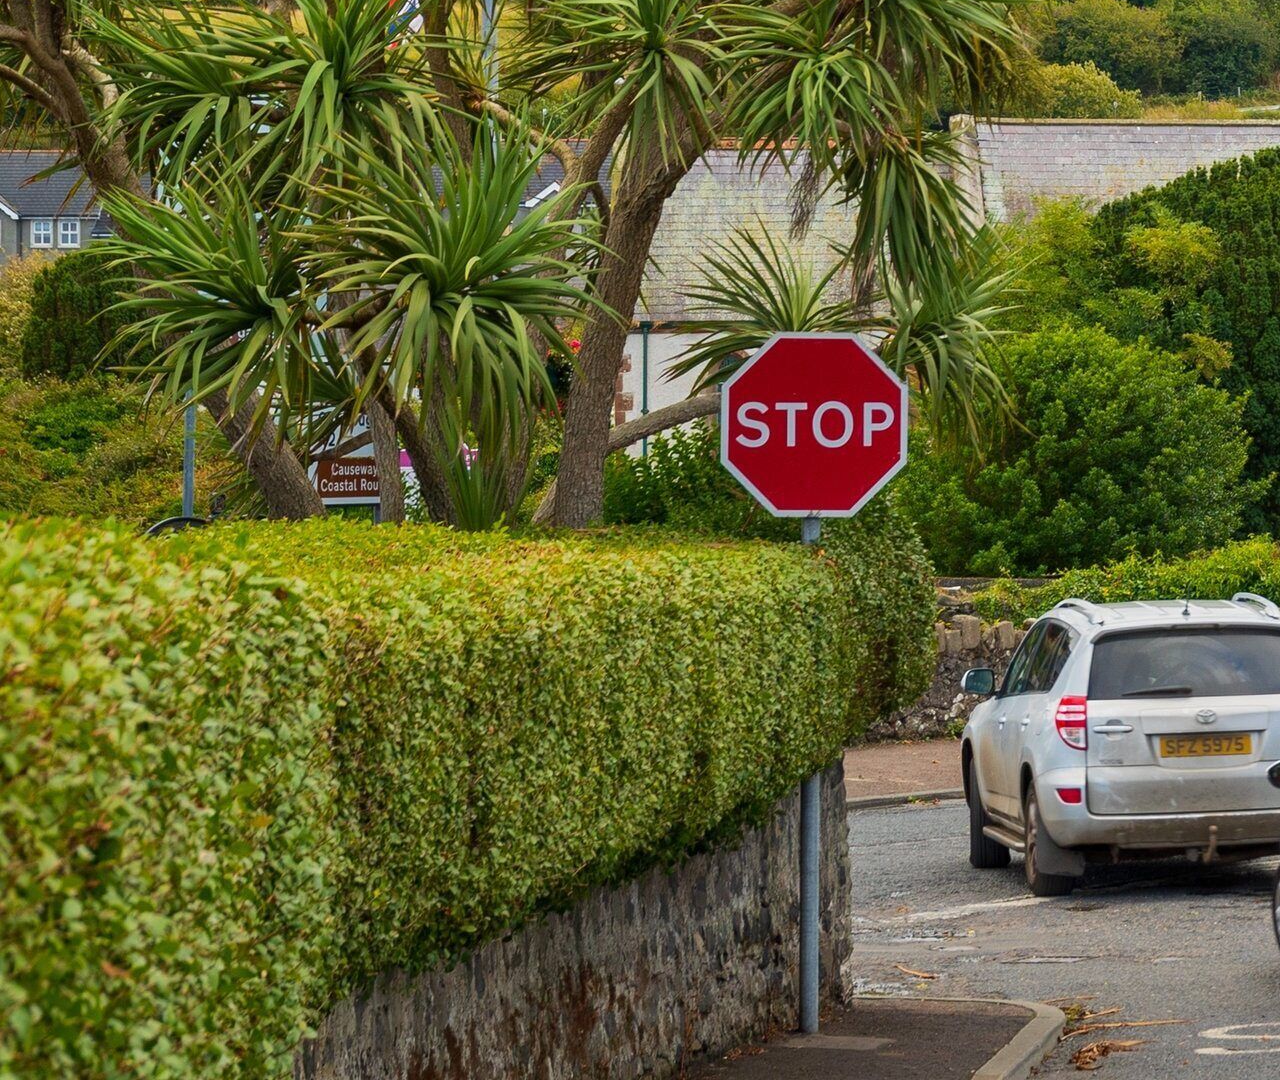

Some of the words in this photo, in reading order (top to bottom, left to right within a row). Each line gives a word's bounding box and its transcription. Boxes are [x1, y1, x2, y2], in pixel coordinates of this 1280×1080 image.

[735, 400, 895, 448] STOP
[331, 463, 379, 477] Causeway
[320, 478, 357, 492] Coastal
[360, 478, 379, 491] Rou
[1165, 738, 1198, 754] SFZ
[1202, 736, 1245, 753] 5975
